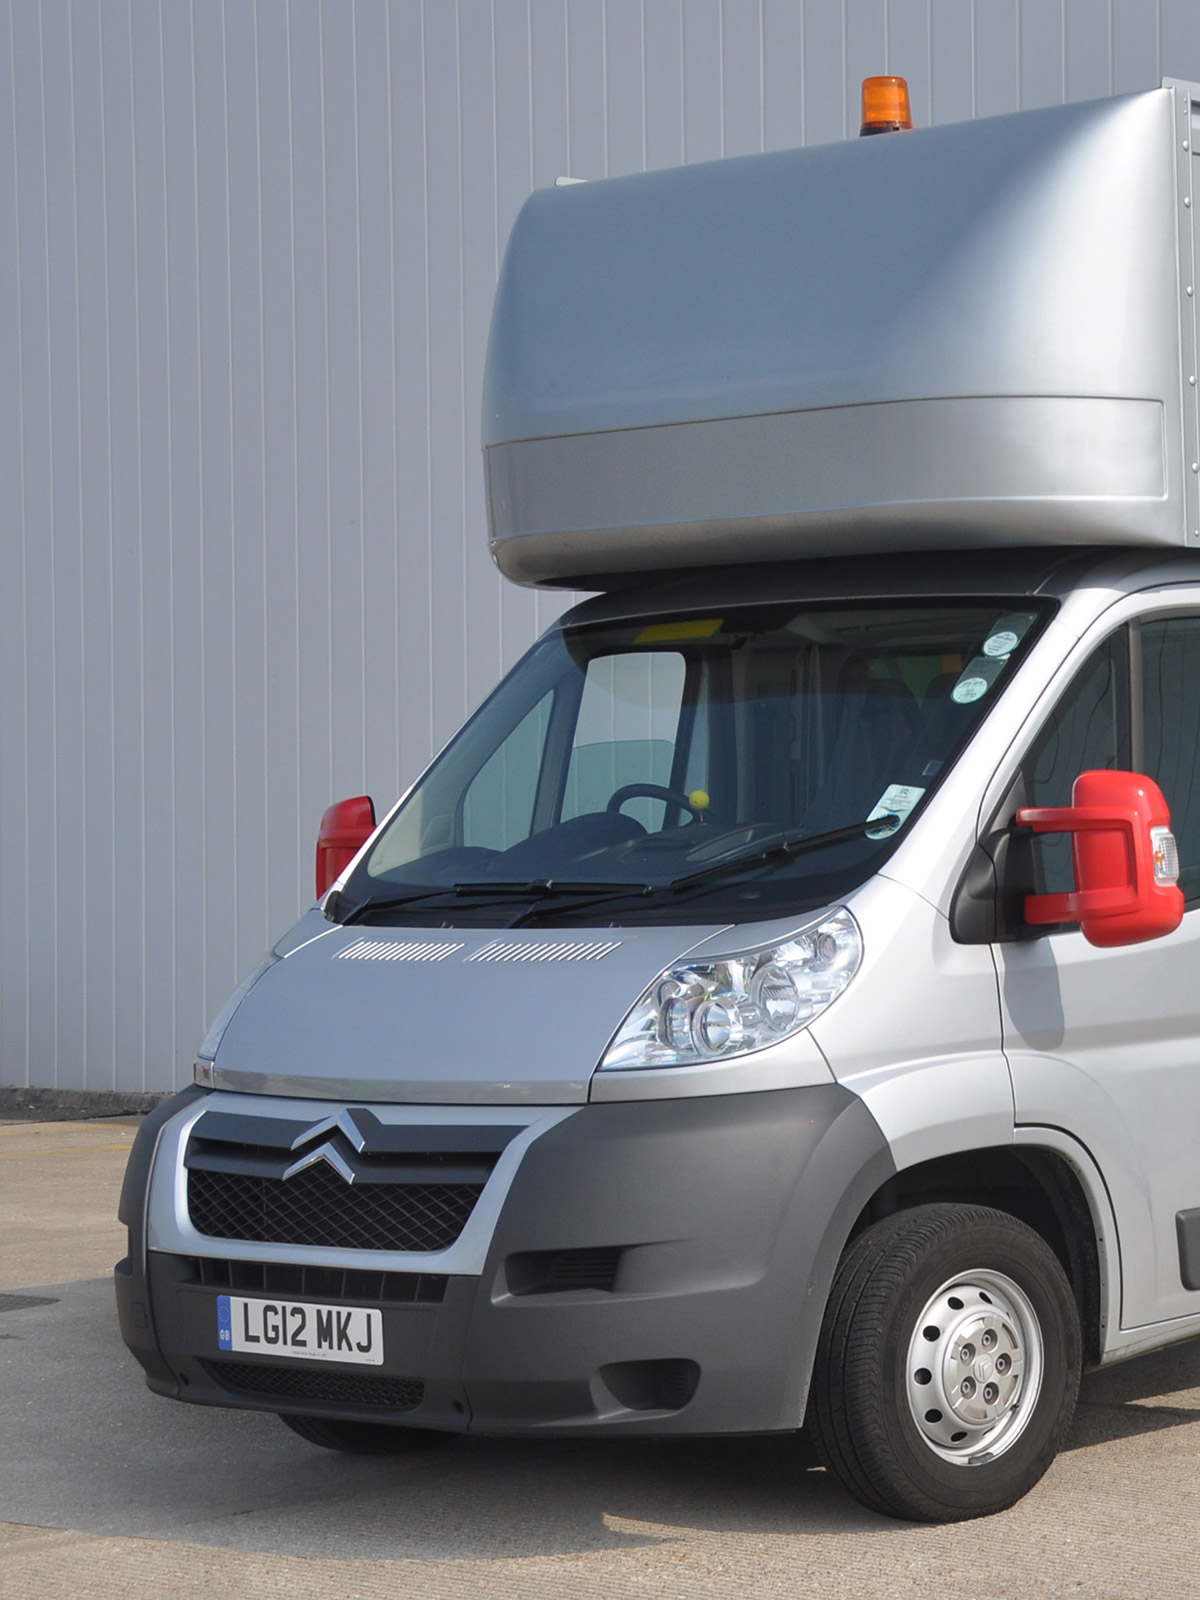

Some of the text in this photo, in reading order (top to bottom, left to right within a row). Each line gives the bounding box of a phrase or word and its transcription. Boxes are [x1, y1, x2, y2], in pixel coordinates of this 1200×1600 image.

[220, 1329, 230, 1341] GB
[243, 1302, 372, 1353] LG12 MKJ
